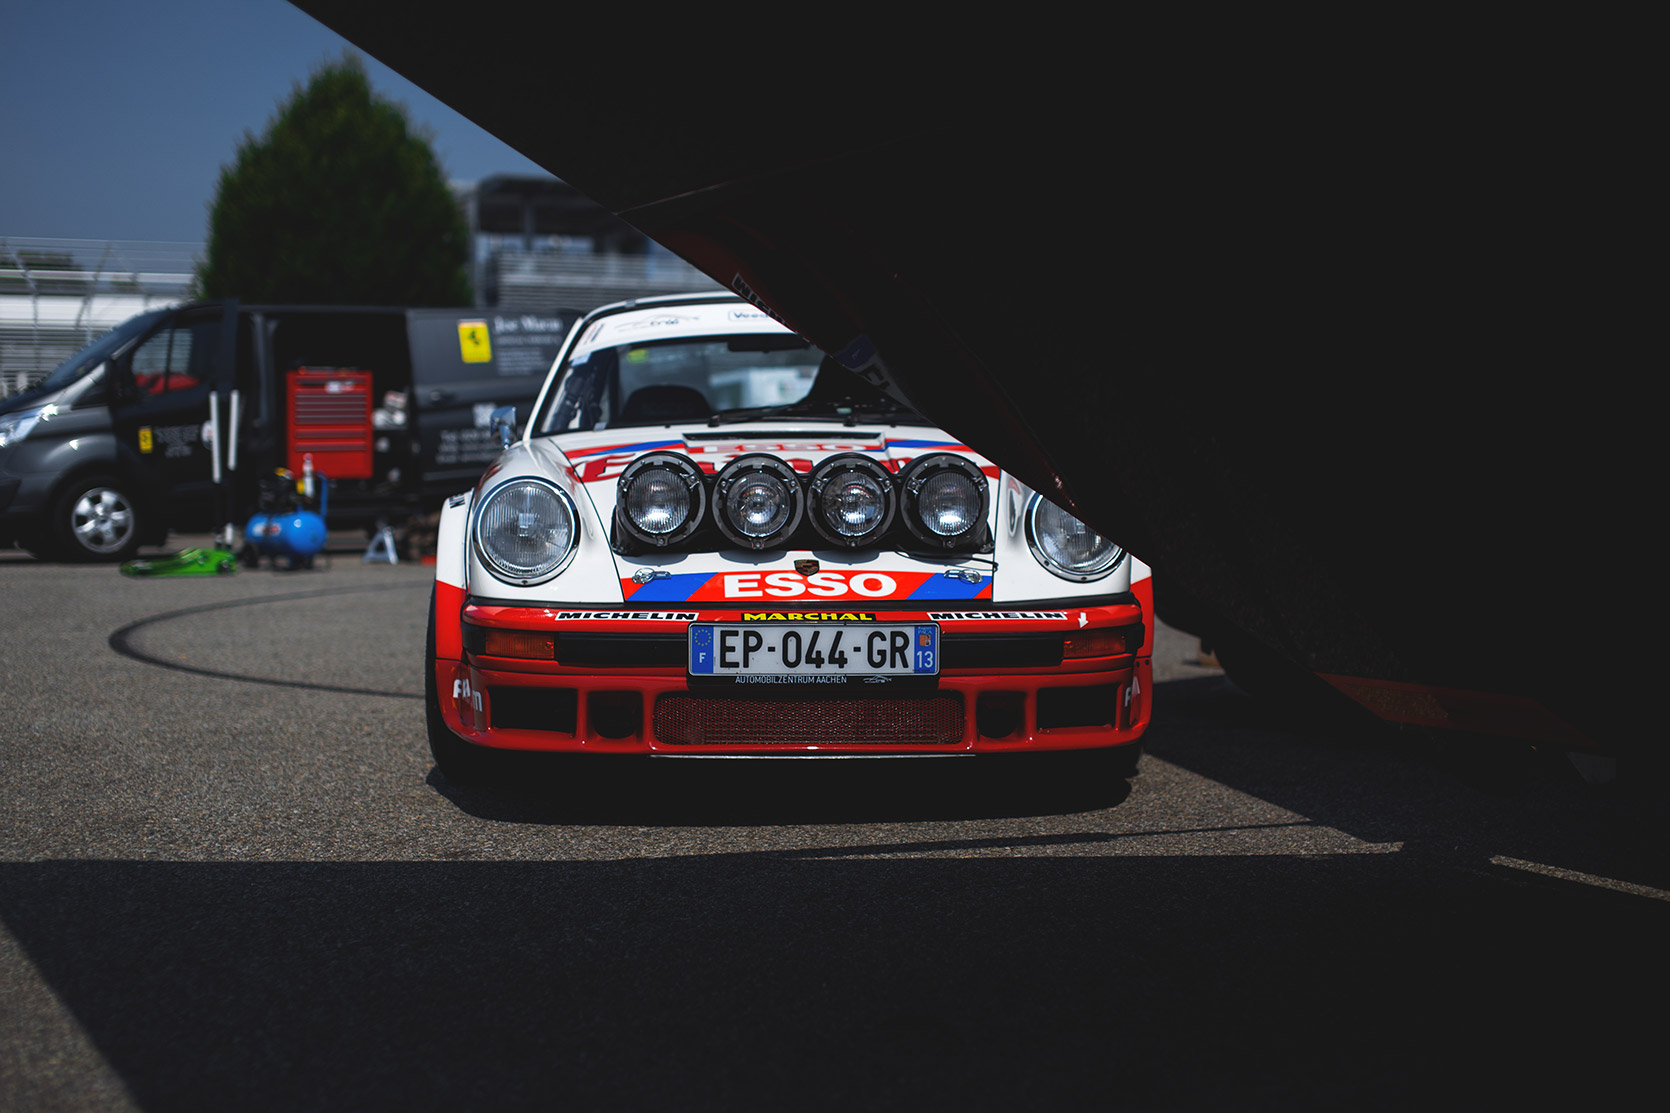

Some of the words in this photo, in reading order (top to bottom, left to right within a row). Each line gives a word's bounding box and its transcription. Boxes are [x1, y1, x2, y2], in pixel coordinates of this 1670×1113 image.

[724, 573, 897, 598] ESSO
[559, 612, 697, 620] MICHELIN
[744, 613, 873, 621] MARCHAL
[931, 612, 1063, 620] MICHELIN
[699, 652, 707, 664] F
[719, 630, 910, 669] EP-044-GR
[916, 650, 934, 669] 13
[735, 675, 815, 684] AUTOMOBILZENTRUM
[816, 675, 847, 684] AACHEN
